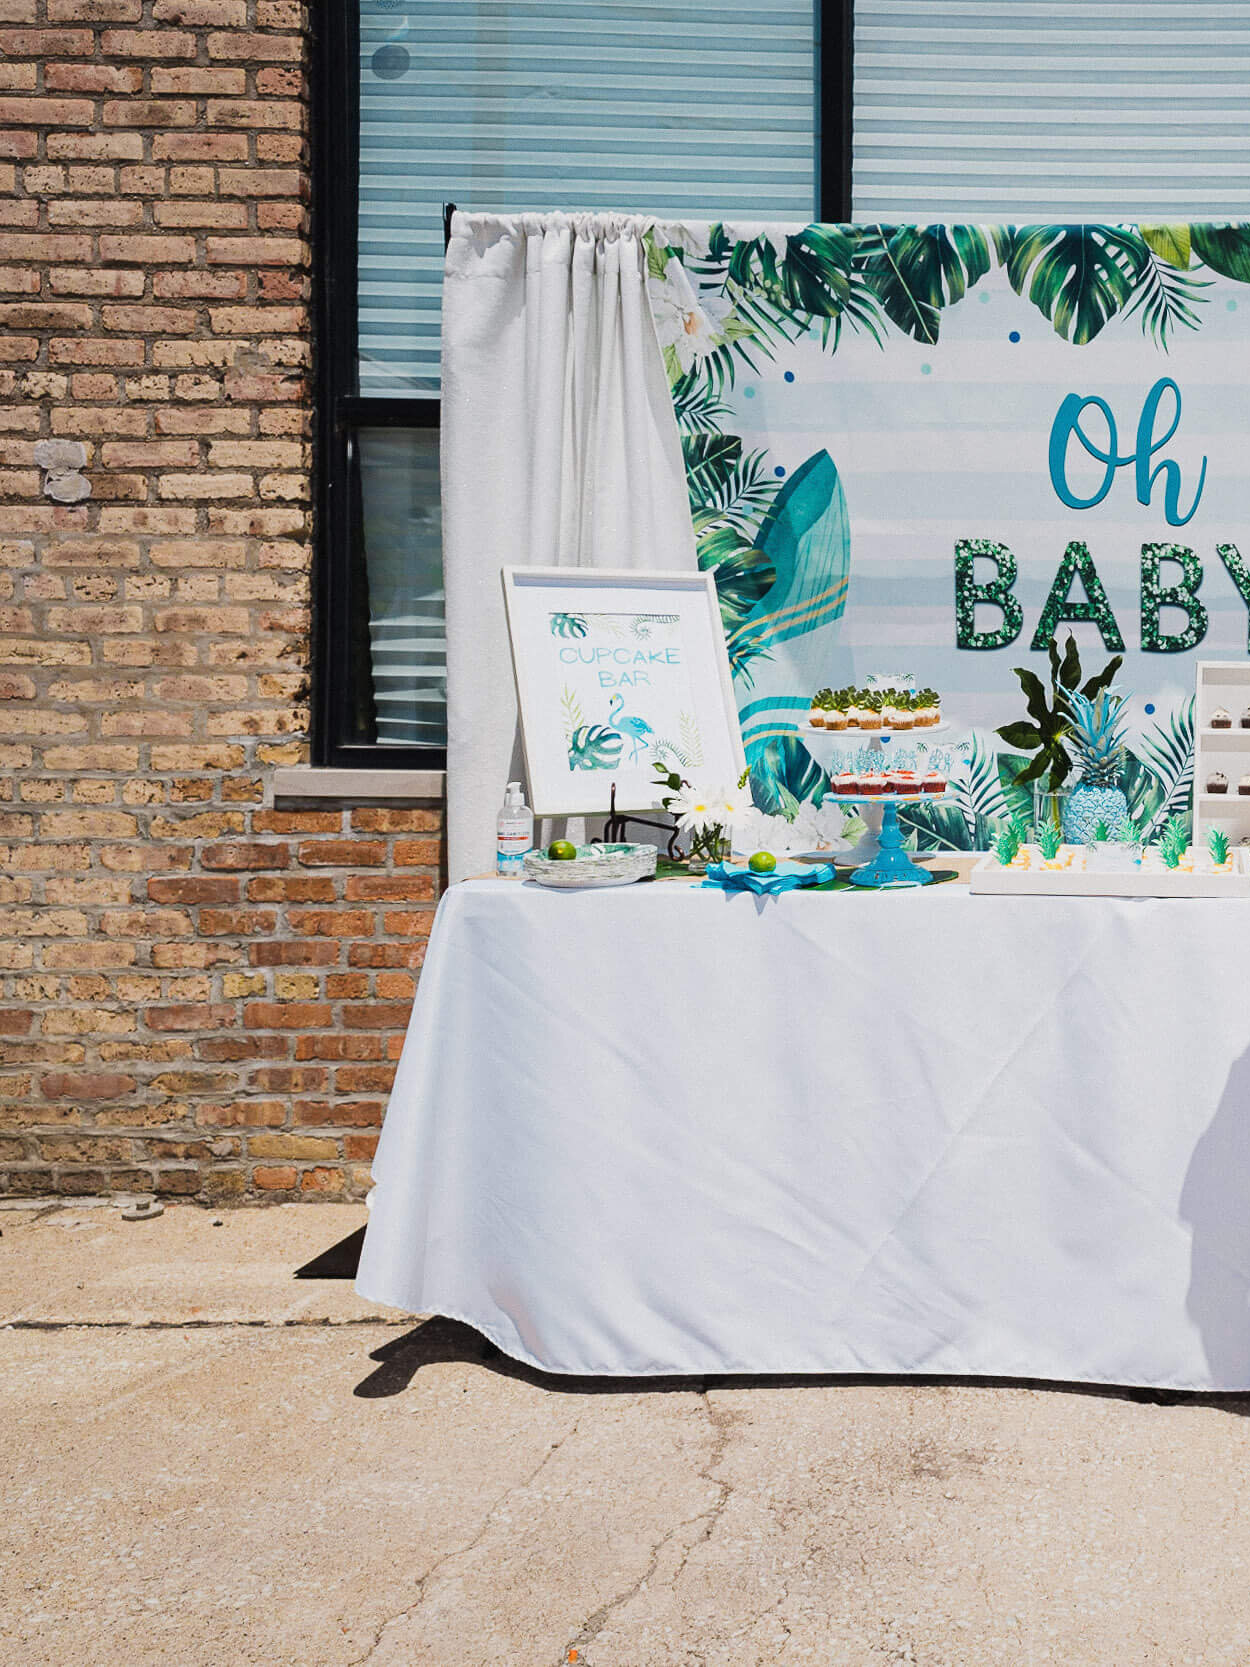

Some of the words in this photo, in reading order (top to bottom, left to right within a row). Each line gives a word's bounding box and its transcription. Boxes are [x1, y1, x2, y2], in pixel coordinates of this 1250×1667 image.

[1049, 377, 1207, 526] Oh
[560, 647, 681, 664] CUPCAKE
[598, 670, 652, 688] BAR
